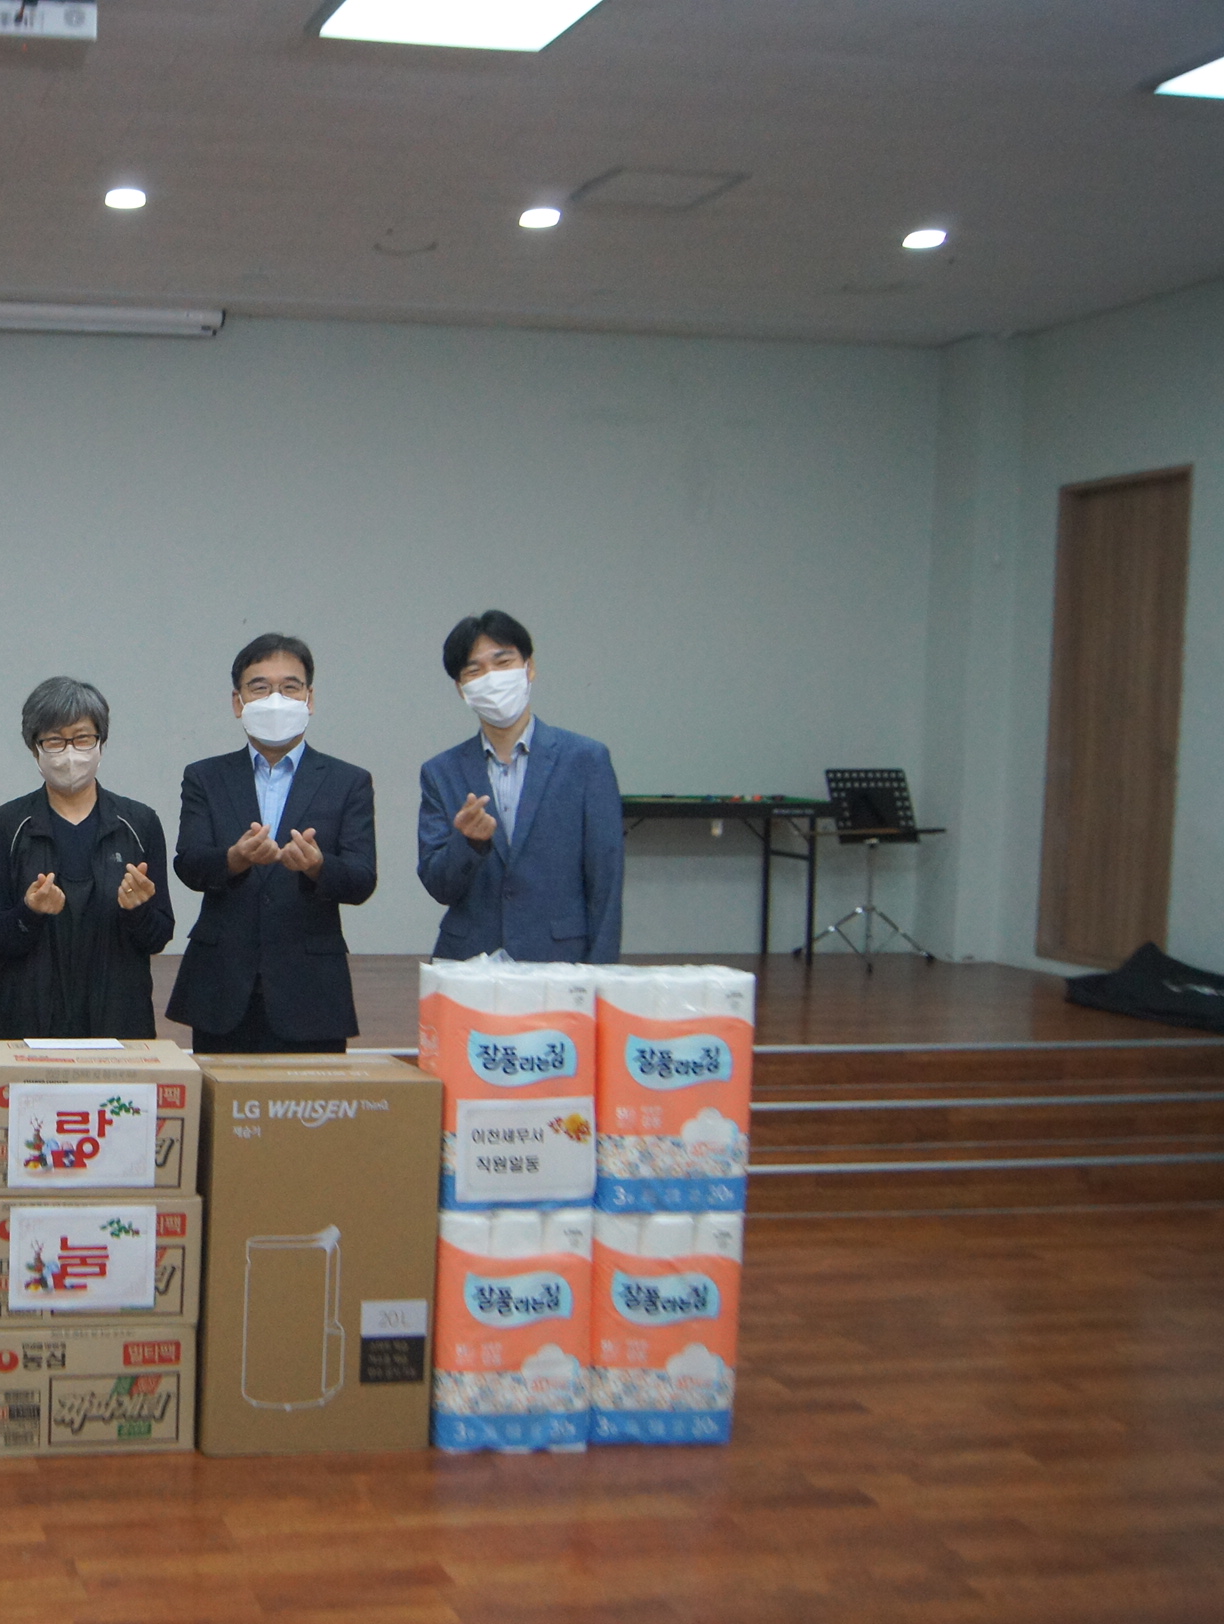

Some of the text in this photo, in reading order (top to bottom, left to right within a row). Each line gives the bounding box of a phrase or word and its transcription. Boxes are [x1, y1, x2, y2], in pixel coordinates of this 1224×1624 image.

[476, 1042, 565, 1075] 잘풀리는집
[635, 1046, 721, 1078] 잘풀리는집
[232, 1100, 261, 1119] LG
[268, 1099, 359, 1128] WHISEN
[56, 1109, 113, 1160] 랑
[472, 1128, 545, 1146] 이천세무서
[476, 1155, 540, 1174] 직원일동
[58, 1235, 109, 1277] 눔
